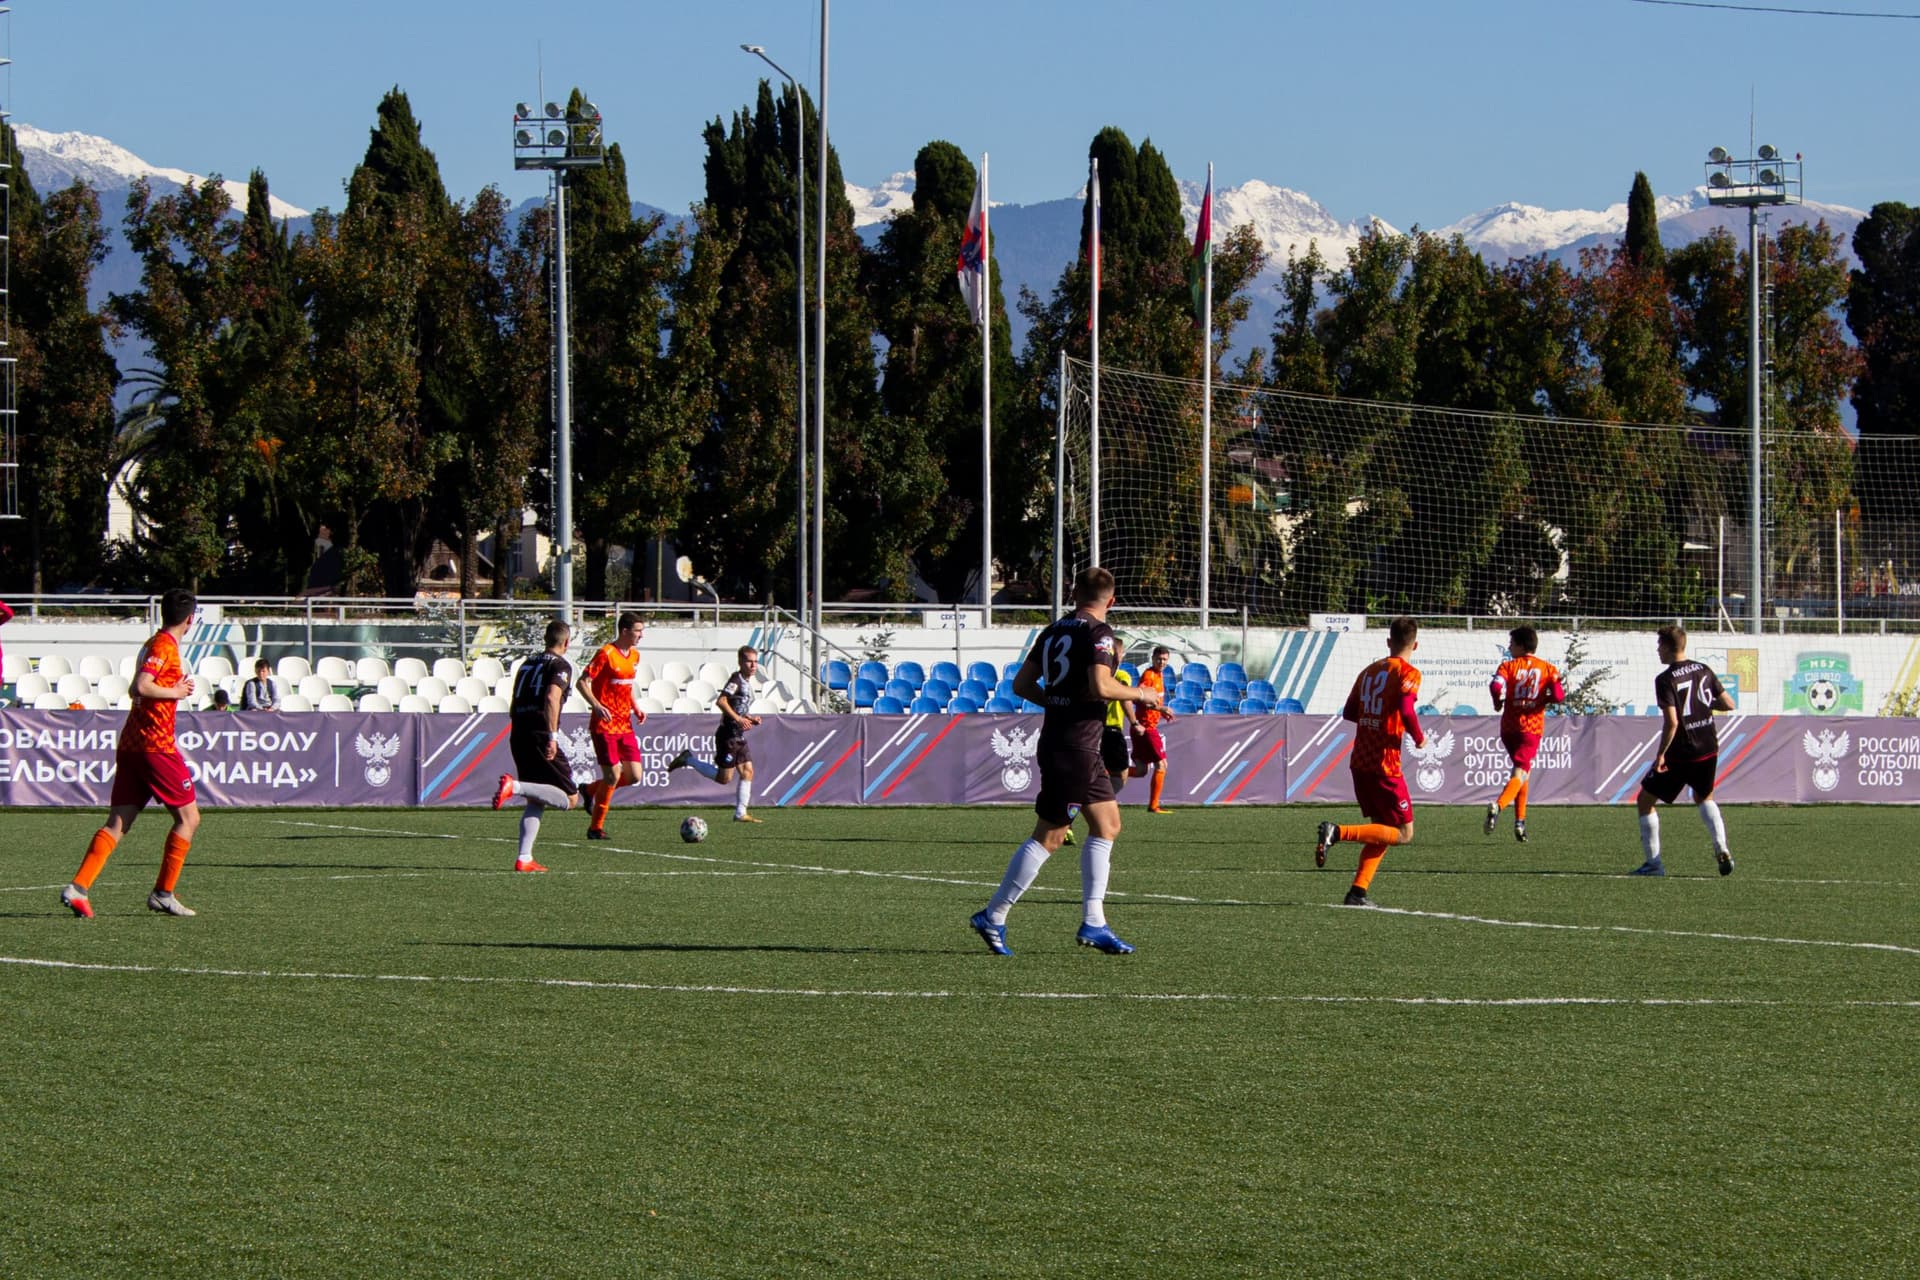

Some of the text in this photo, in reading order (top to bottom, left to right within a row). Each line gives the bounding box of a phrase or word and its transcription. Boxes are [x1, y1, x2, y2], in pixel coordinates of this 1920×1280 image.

[1042, 634, 1073, 687] 13
[516, 663, 544, 698] 74
[1360, 670, 1389, 715] 42
[1677, 675, 1713, 716] 76
[0, 728, 318, 752] ОВАНИЯ ФУТБОЛУ
[1463, 734, 1572, 752] РОССКИЙ
[1859, 736, 1920, 753] РОССИЙ
[1463, 752, 1572, 769] ФУТБОЬНЫЙ
[0, 759, 318, 788] ЕЛЬСКИ ОМАНД»
[1463, 770, 1512, 787] СОЮЗ
[1858, 770, 1903, 786] СОЮЗ
